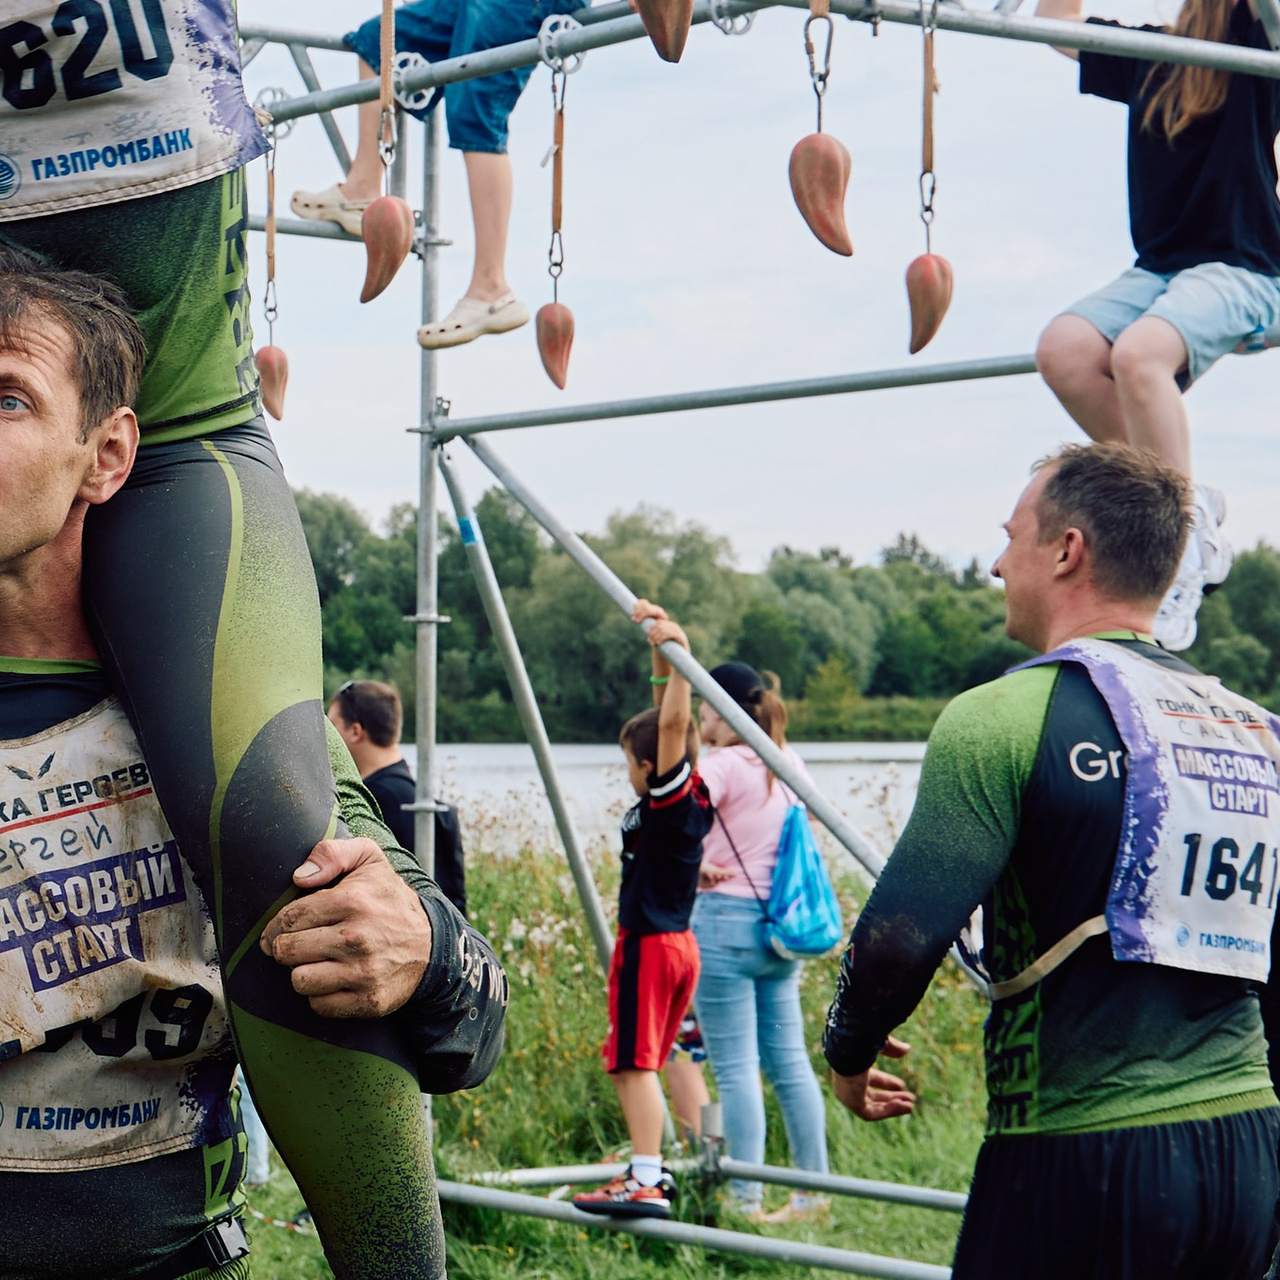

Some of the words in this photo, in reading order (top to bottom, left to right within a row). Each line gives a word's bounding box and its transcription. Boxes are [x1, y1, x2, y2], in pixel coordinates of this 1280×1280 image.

[31, 128, 193, 181] ГАЗПРОМБАНК
[38, 762, 150, 812] ГЕРОЕВ
[1211, 782, 1266, 815] СТАРТ
[31, 917, 132, 984] СТАРТ
[16, 1097, 161, 1131] ГАЗПРОМБАНК
